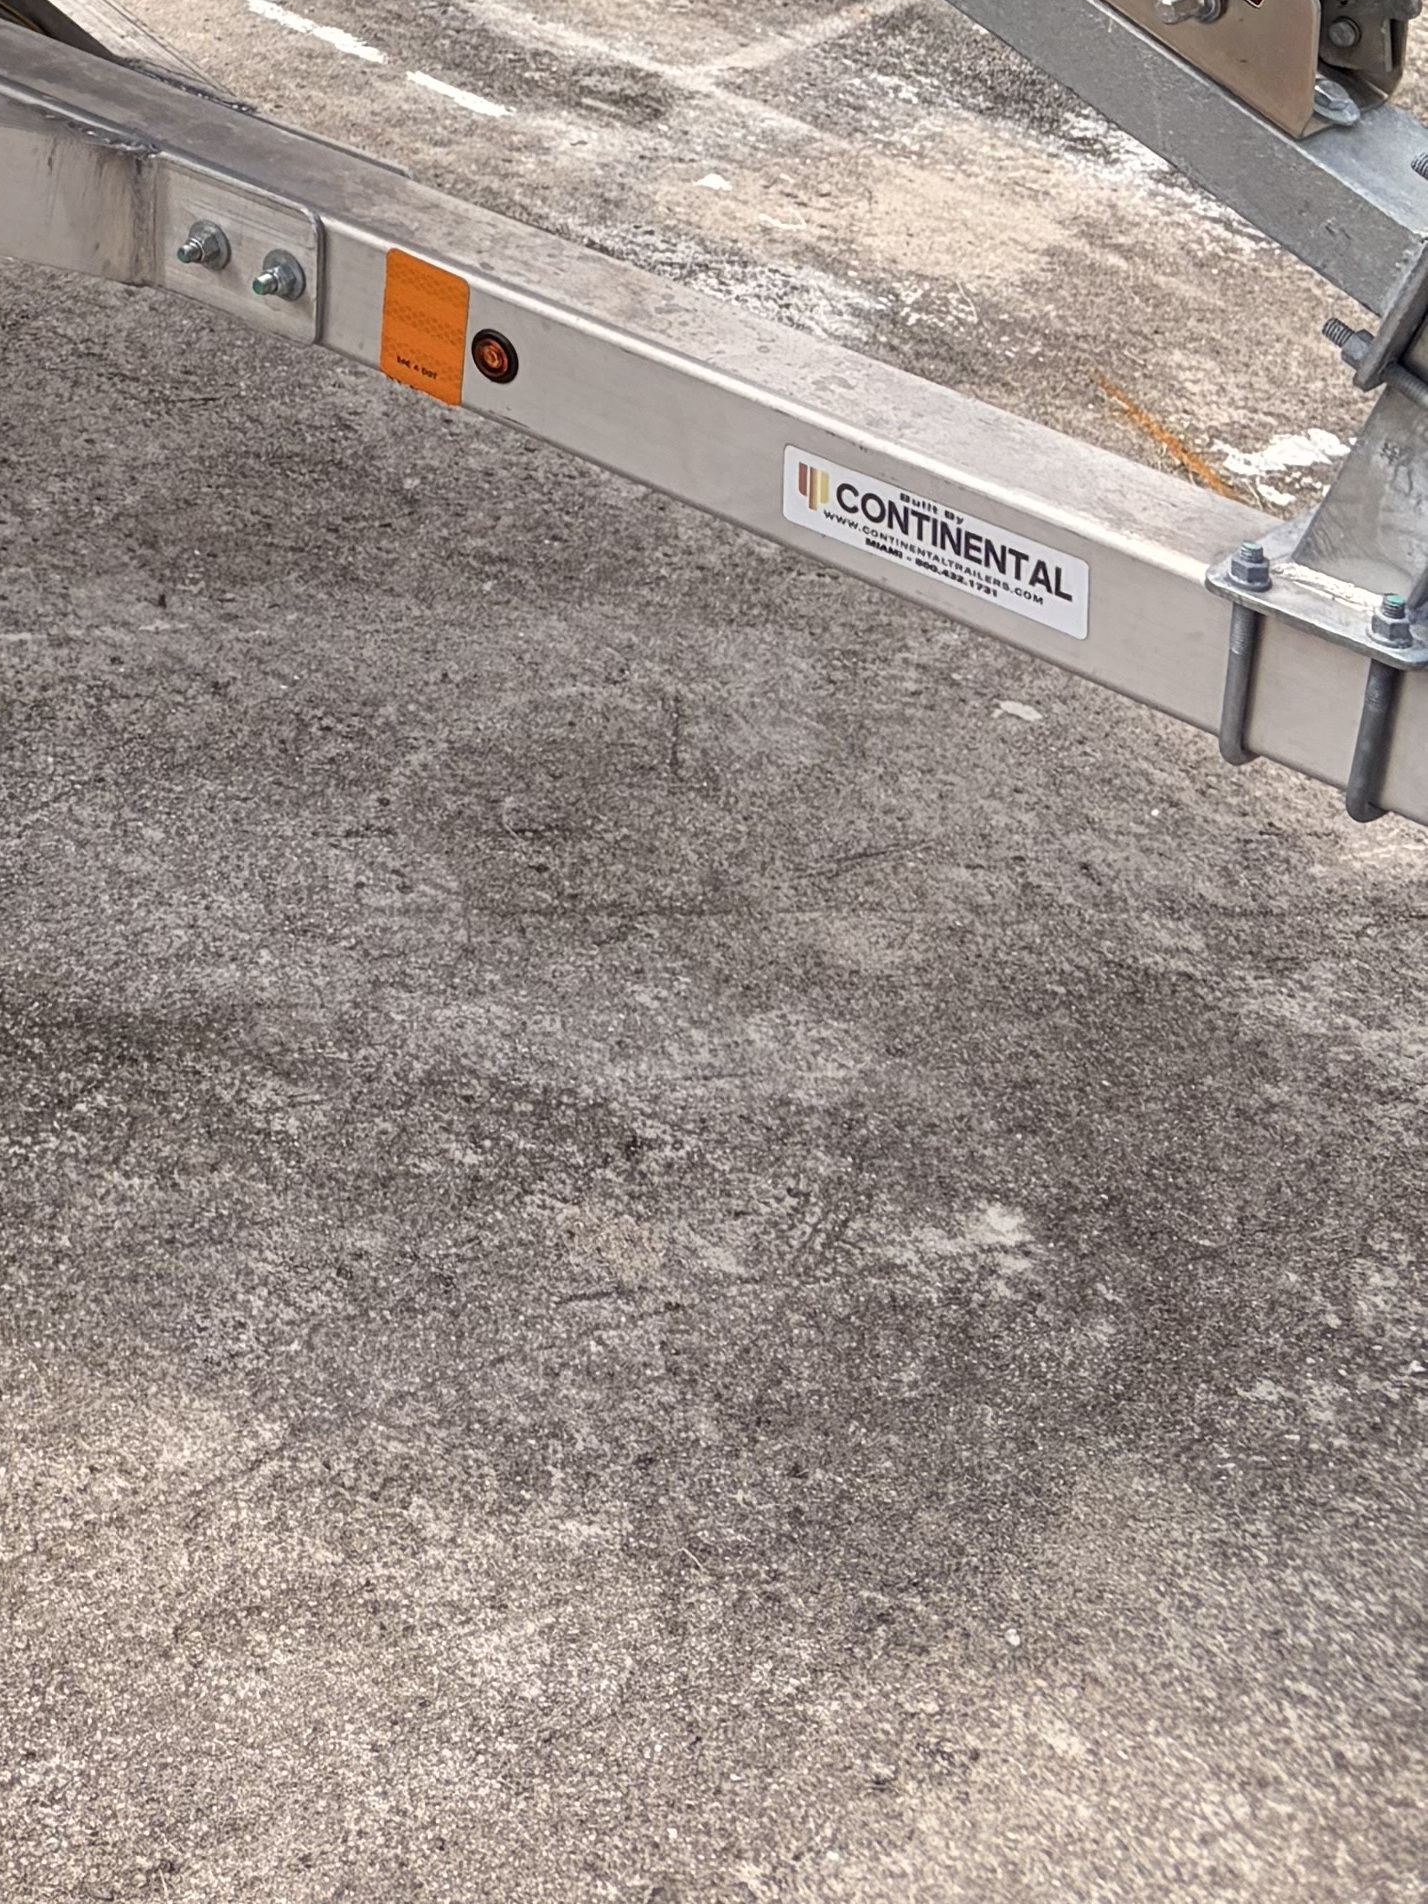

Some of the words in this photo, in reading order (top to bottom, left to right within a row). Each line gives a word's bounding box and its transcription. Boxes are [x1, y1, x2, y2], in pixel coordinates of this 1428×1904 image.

[899, 492, 938, 514] Built
[944, 509, 964, 525] By
[823, 509, 1044, 605] WWW.CONTINENTALTRAILERS.COM
[836, 483, 1073, 603] CONTINENTAL
[865, 537, 903, 560] MIAMI
